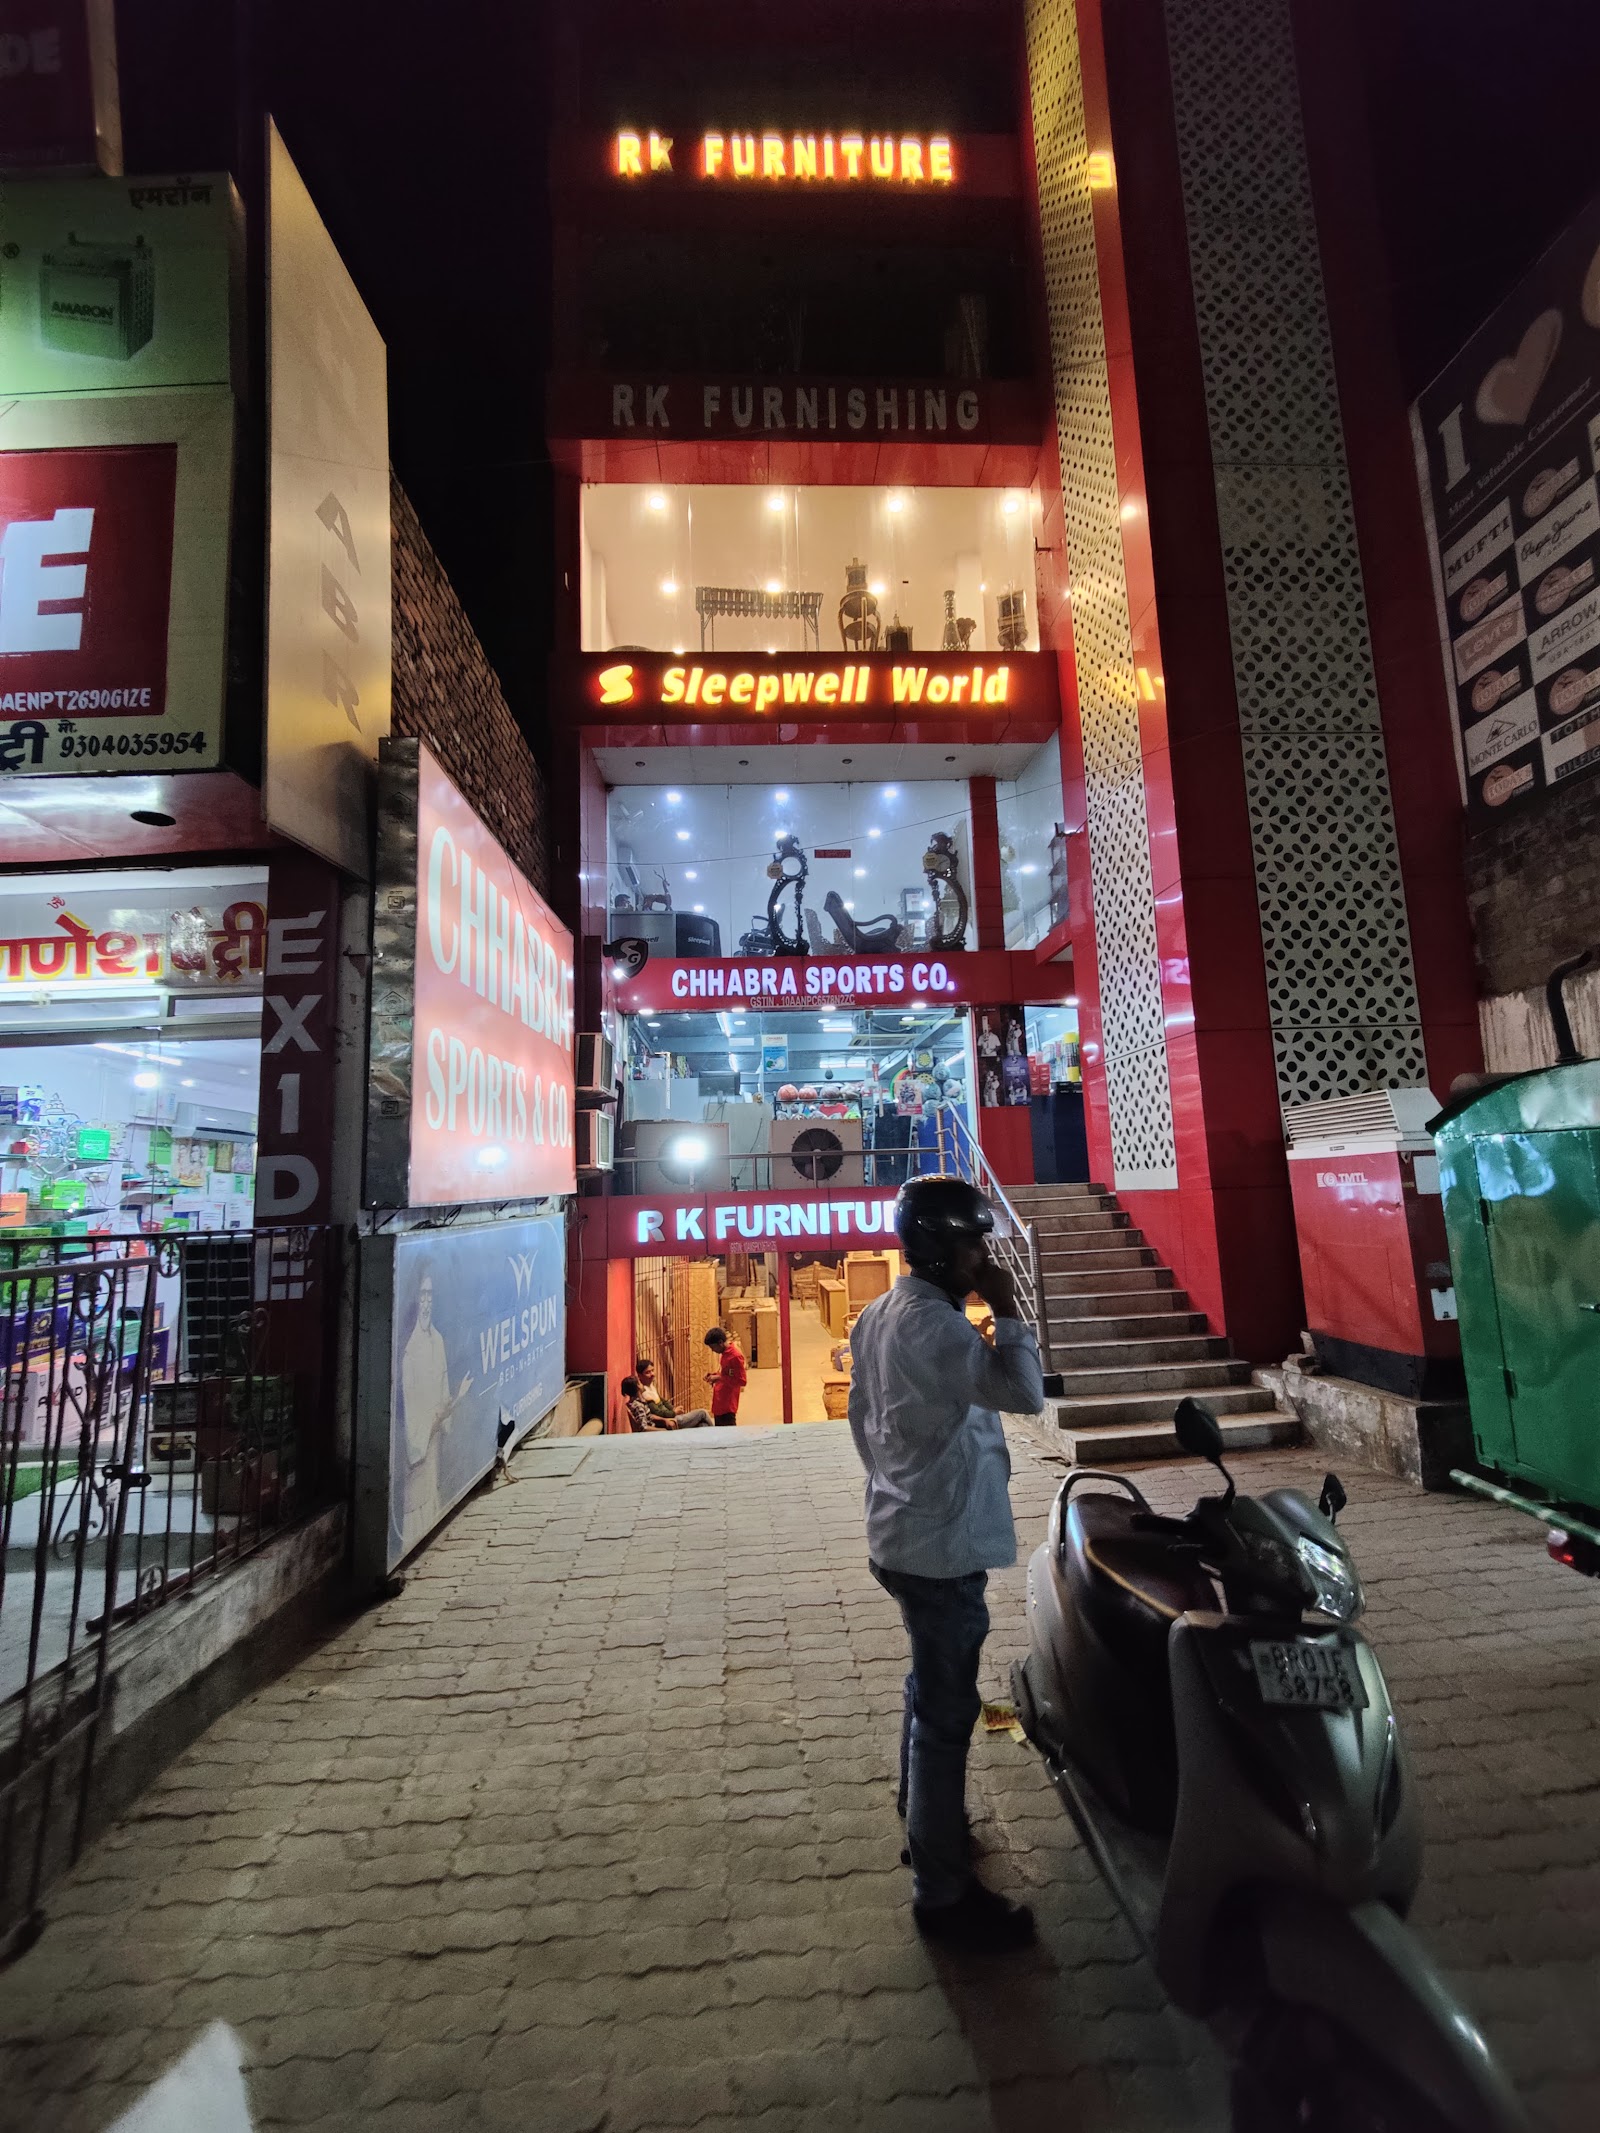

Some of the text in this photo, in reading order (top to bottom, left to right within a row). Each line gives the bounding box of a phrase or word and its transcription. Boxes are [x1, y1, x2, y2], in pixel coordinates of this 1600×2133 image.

[704, 133, 952, 182] FURNITURE
[128, 176, 213, 209] एमरॉन
[52, 301, 114, 320] AMARON
[612, 384, 980, 430] RK FURNISHING
[1447, 515, 1511, 580] MUFTI
[1541, 600, 1598, 650] ARROW
[0, 688, 151, 712] AENPT2690G1ZE
[660, 665, 872, 712] Sleepwell
[892, 665, 1010, 705] World
[59, 732, 206, 763] 9304035954
[1470, 720, 1538, 767] MONTE CARLO
[427, 826, 571, 1052] CHHABRA
[671, 962, 956, 997] CHHABRA SPORTS CO.
[426, 1027, 573, 1149] SPORTS & CO.
[637, 1209, 665, 1242] R
[676, 1207, 707, 1241] K
[480, 1295, 557, 1374] WELSPUN
